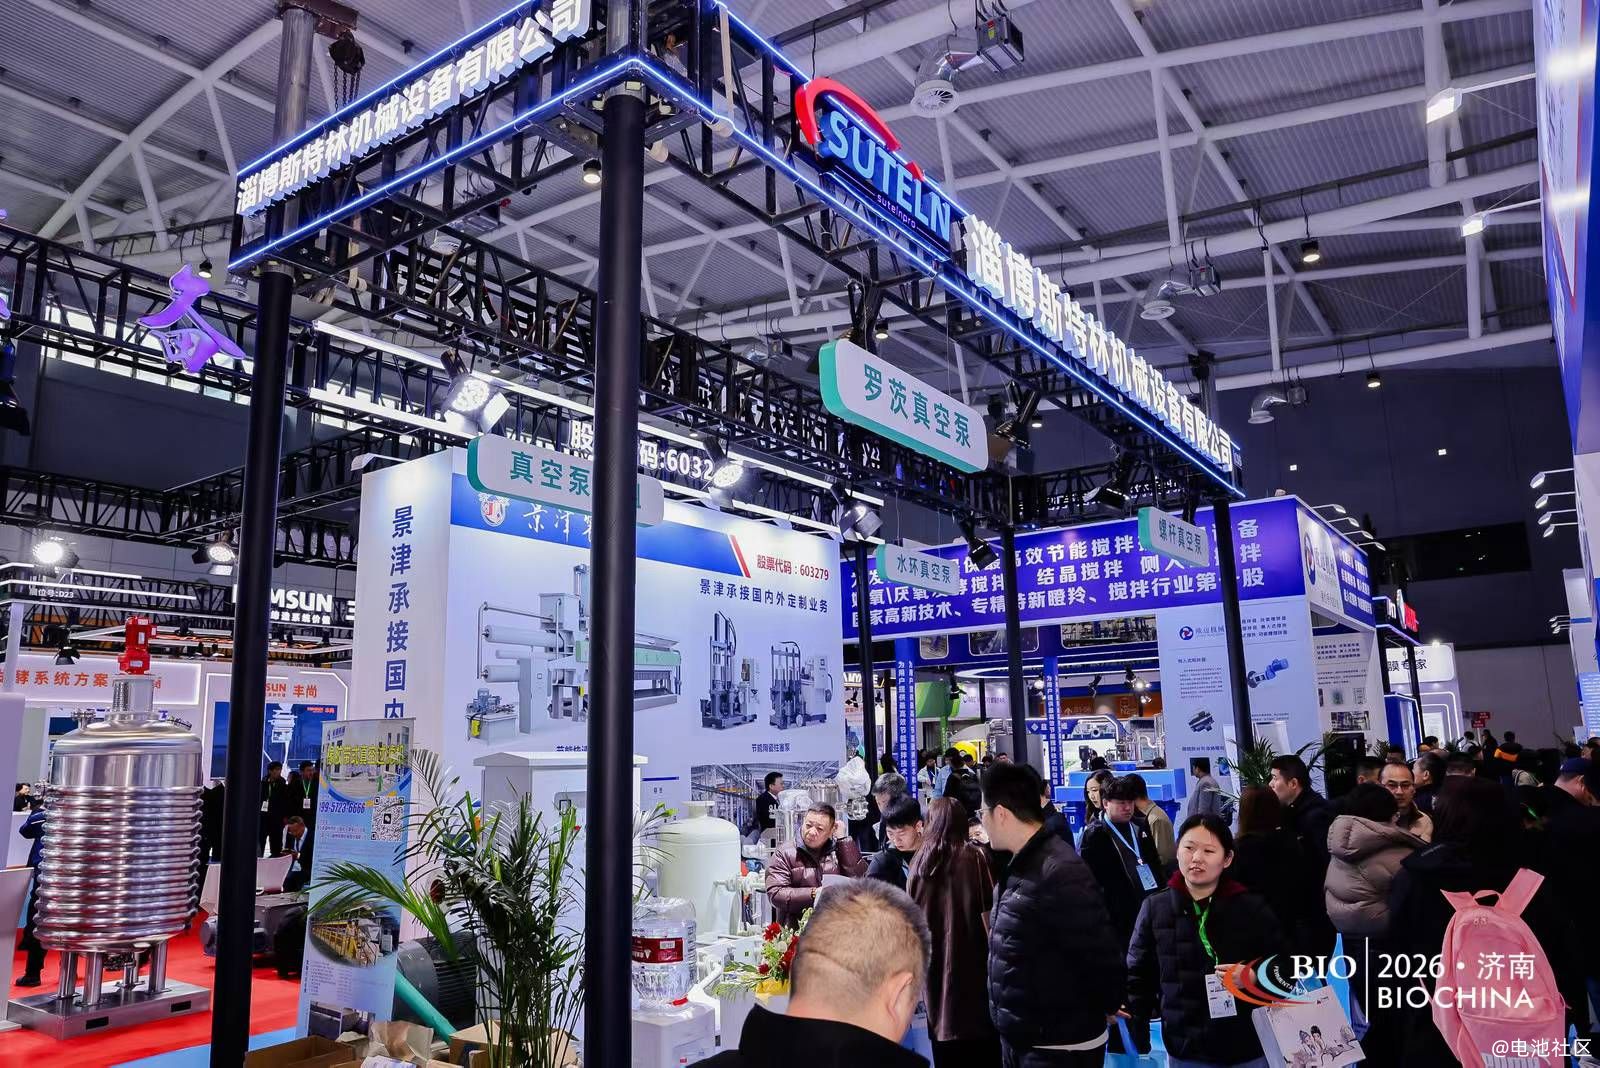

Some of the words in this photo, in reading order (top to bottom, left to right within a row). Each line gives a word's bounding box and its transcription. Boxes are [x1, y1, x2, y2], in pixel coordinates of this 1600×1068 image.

[237, 0, 590, 216] 淄博斯特林机械设备有限公司
[828, 111, 950, 242] SUTELN
[964, 214, 1233, 471] 淄博斯特林机械设备有限公司
[863, 362, 971, 449] 罗茨真空泵
[1158, 512, 1203, 555] 螺杆真空泵
[756, 554, 829, 581] 股票代码：603279
[896, 553, 951, 584] 水环真空泵
[1036, 559, 1124, 586] 结晶搅拌
[384, 505, 414, 718] 景津承接国内
[699, 578, 828, 613] 景津承接国内外定制业务
[293, 682, 318, 698] 丰尚
